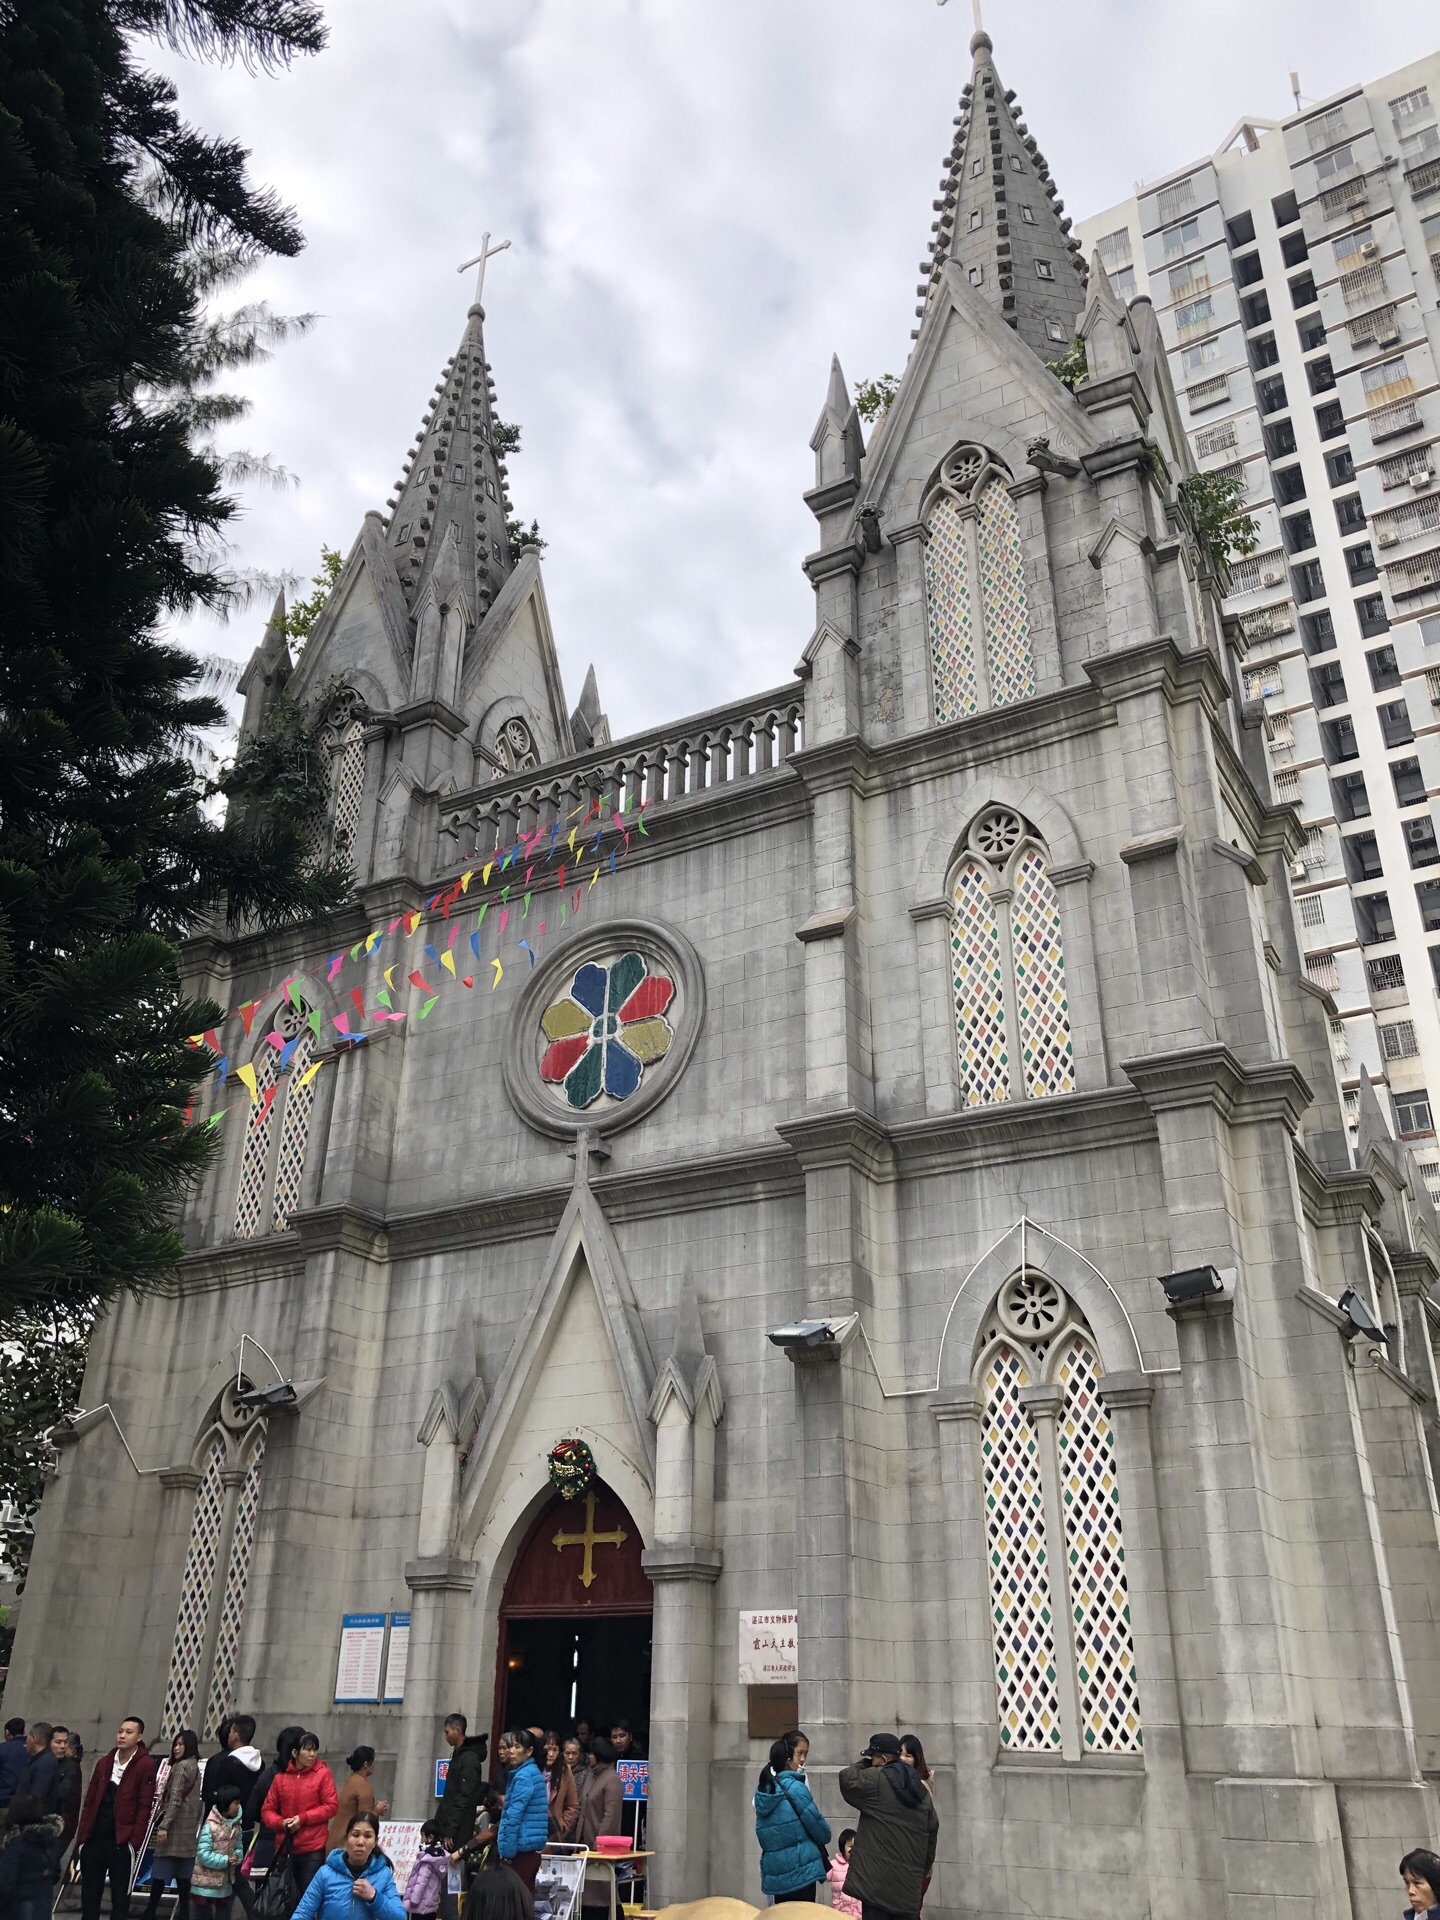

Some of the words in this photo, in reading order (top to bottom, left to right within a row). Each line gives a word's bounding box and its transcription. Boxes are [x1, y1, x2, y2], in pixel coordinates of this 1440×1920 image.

[753, 1637, 798, 1650] 霞山天主教
[619, 1764, 648, 1782] 请关手
